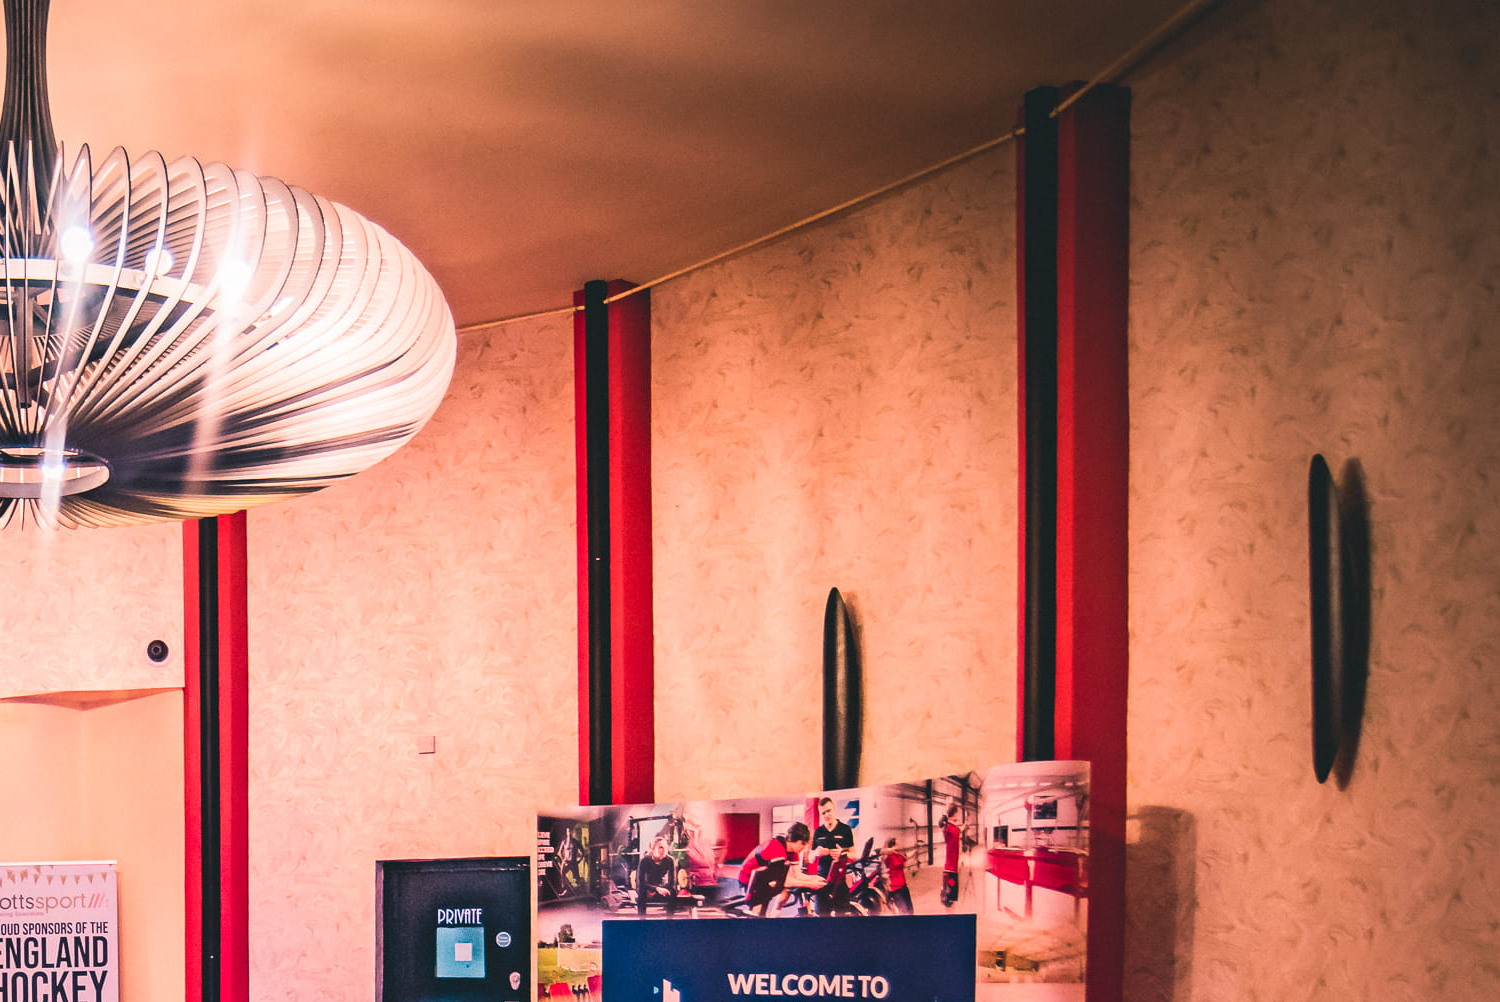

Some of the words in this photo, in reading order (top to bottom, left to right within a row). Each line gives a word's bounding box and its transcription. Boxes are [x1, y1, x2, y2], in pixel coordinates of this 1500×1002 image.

[437, 908, 483, 924] PRIVATE
[22, 922, 73, 935] SPONSORS
[75, 921, 88, 935] OF
[90, 921, 109, 934] THE
[727, 973, 855, 998] WELCOME
[858, 975, 889, 999] TO
